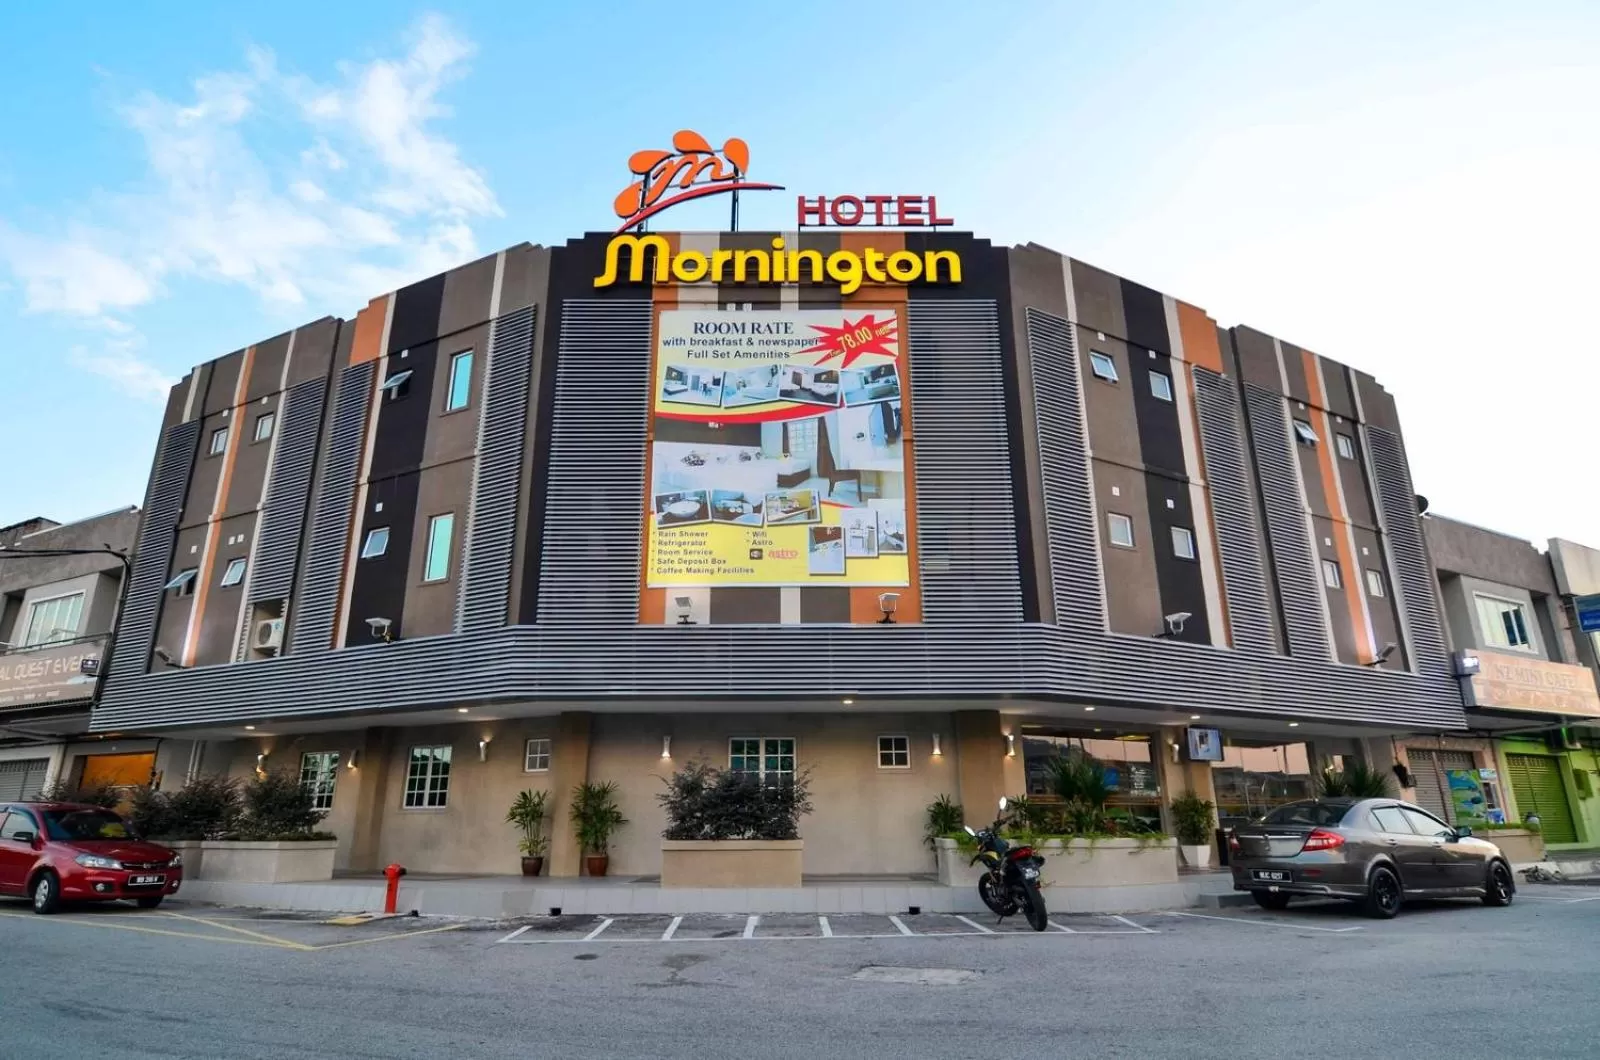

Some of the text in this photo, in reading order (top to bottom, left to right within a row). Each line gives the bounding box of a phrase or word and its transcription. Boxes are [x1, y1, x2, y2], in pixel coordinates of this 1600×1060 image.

[798, 195, 954, 226] HOTEL
[593, 233, 962, 295] Mornington
[694, 322, 794, 334] ROOM RATE
[663, 336, 818, 348] with breakfast & newspaper
[836, 326, 873, 353] 78.00
[687, 349, 790, 359] Full Set Amenities
[677, 558, 709, 566] Deposit
[656, 566, 683, 574] Coffee
[686, 567, 715, 575] Making
